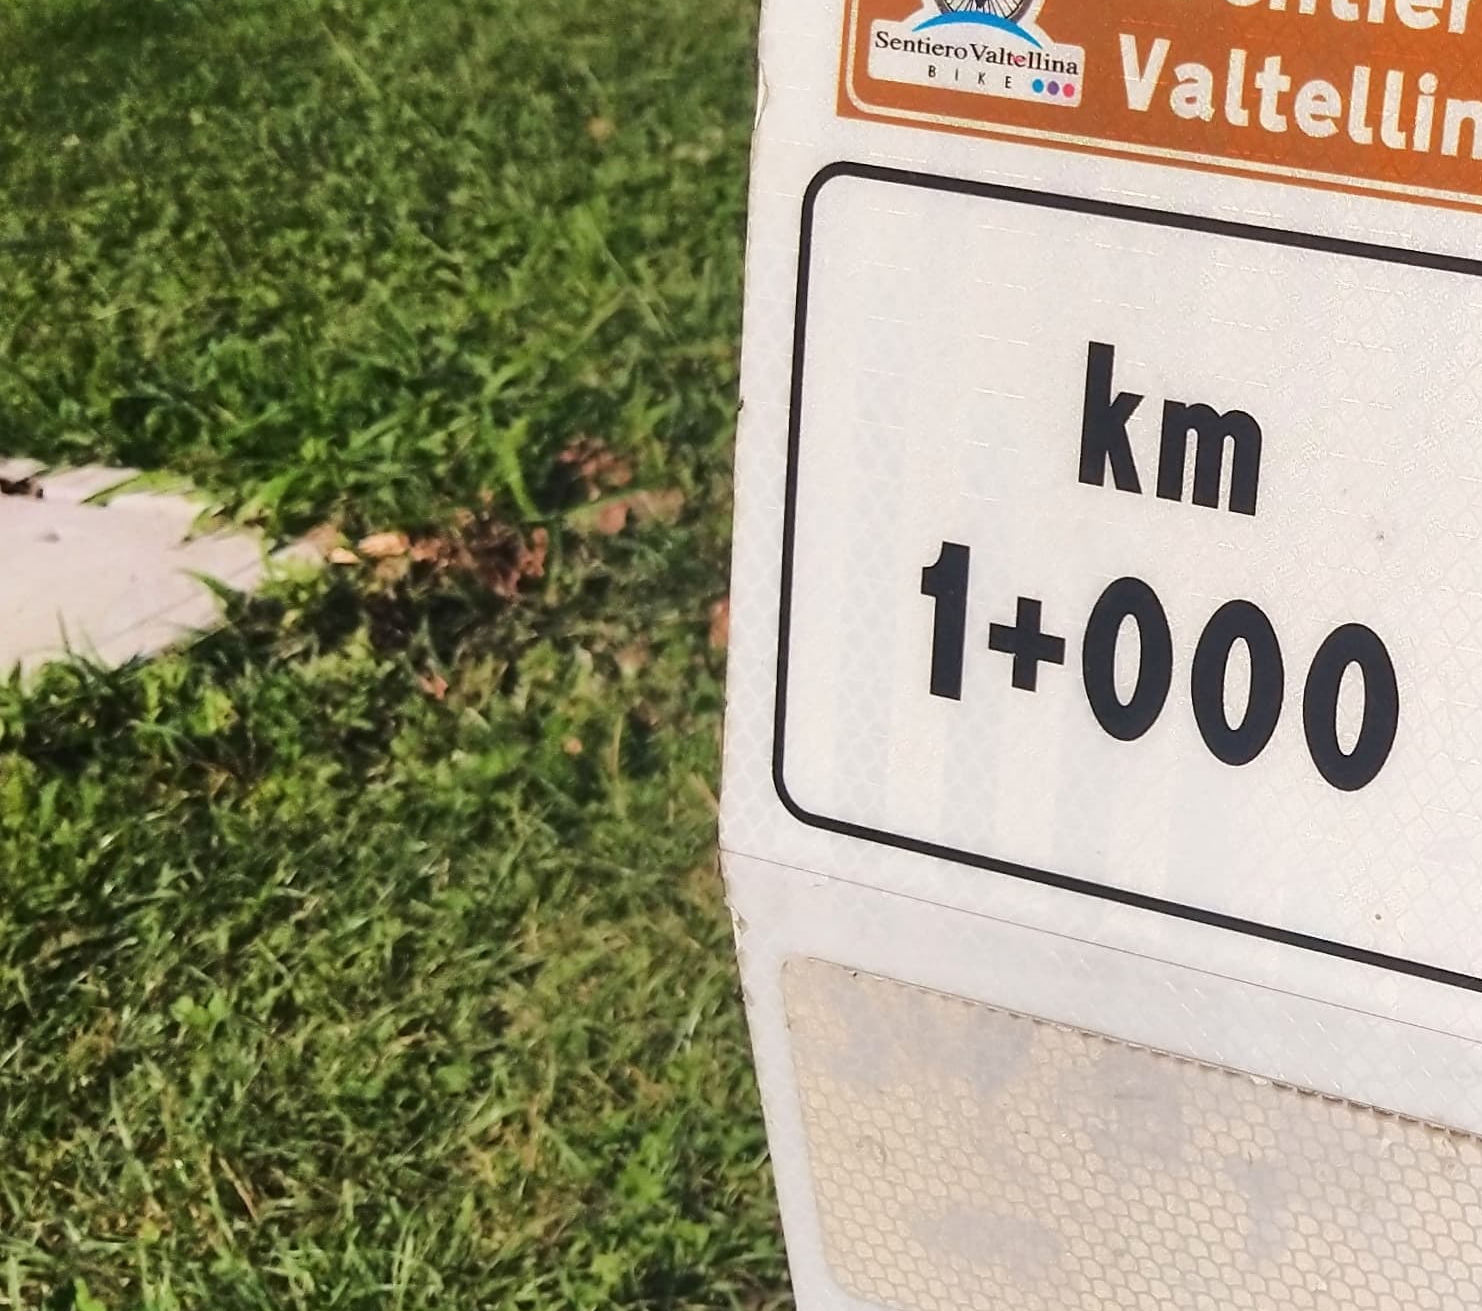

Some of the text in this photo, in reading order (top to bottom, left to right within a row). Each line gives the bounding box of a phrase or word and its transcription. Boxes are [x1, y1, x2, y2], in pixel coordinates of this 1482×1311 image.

[928, 65, 1013, 89] BIKE
[1079, 341, 1263, 516] km
[921, 541, 1400, 792] 1+000
